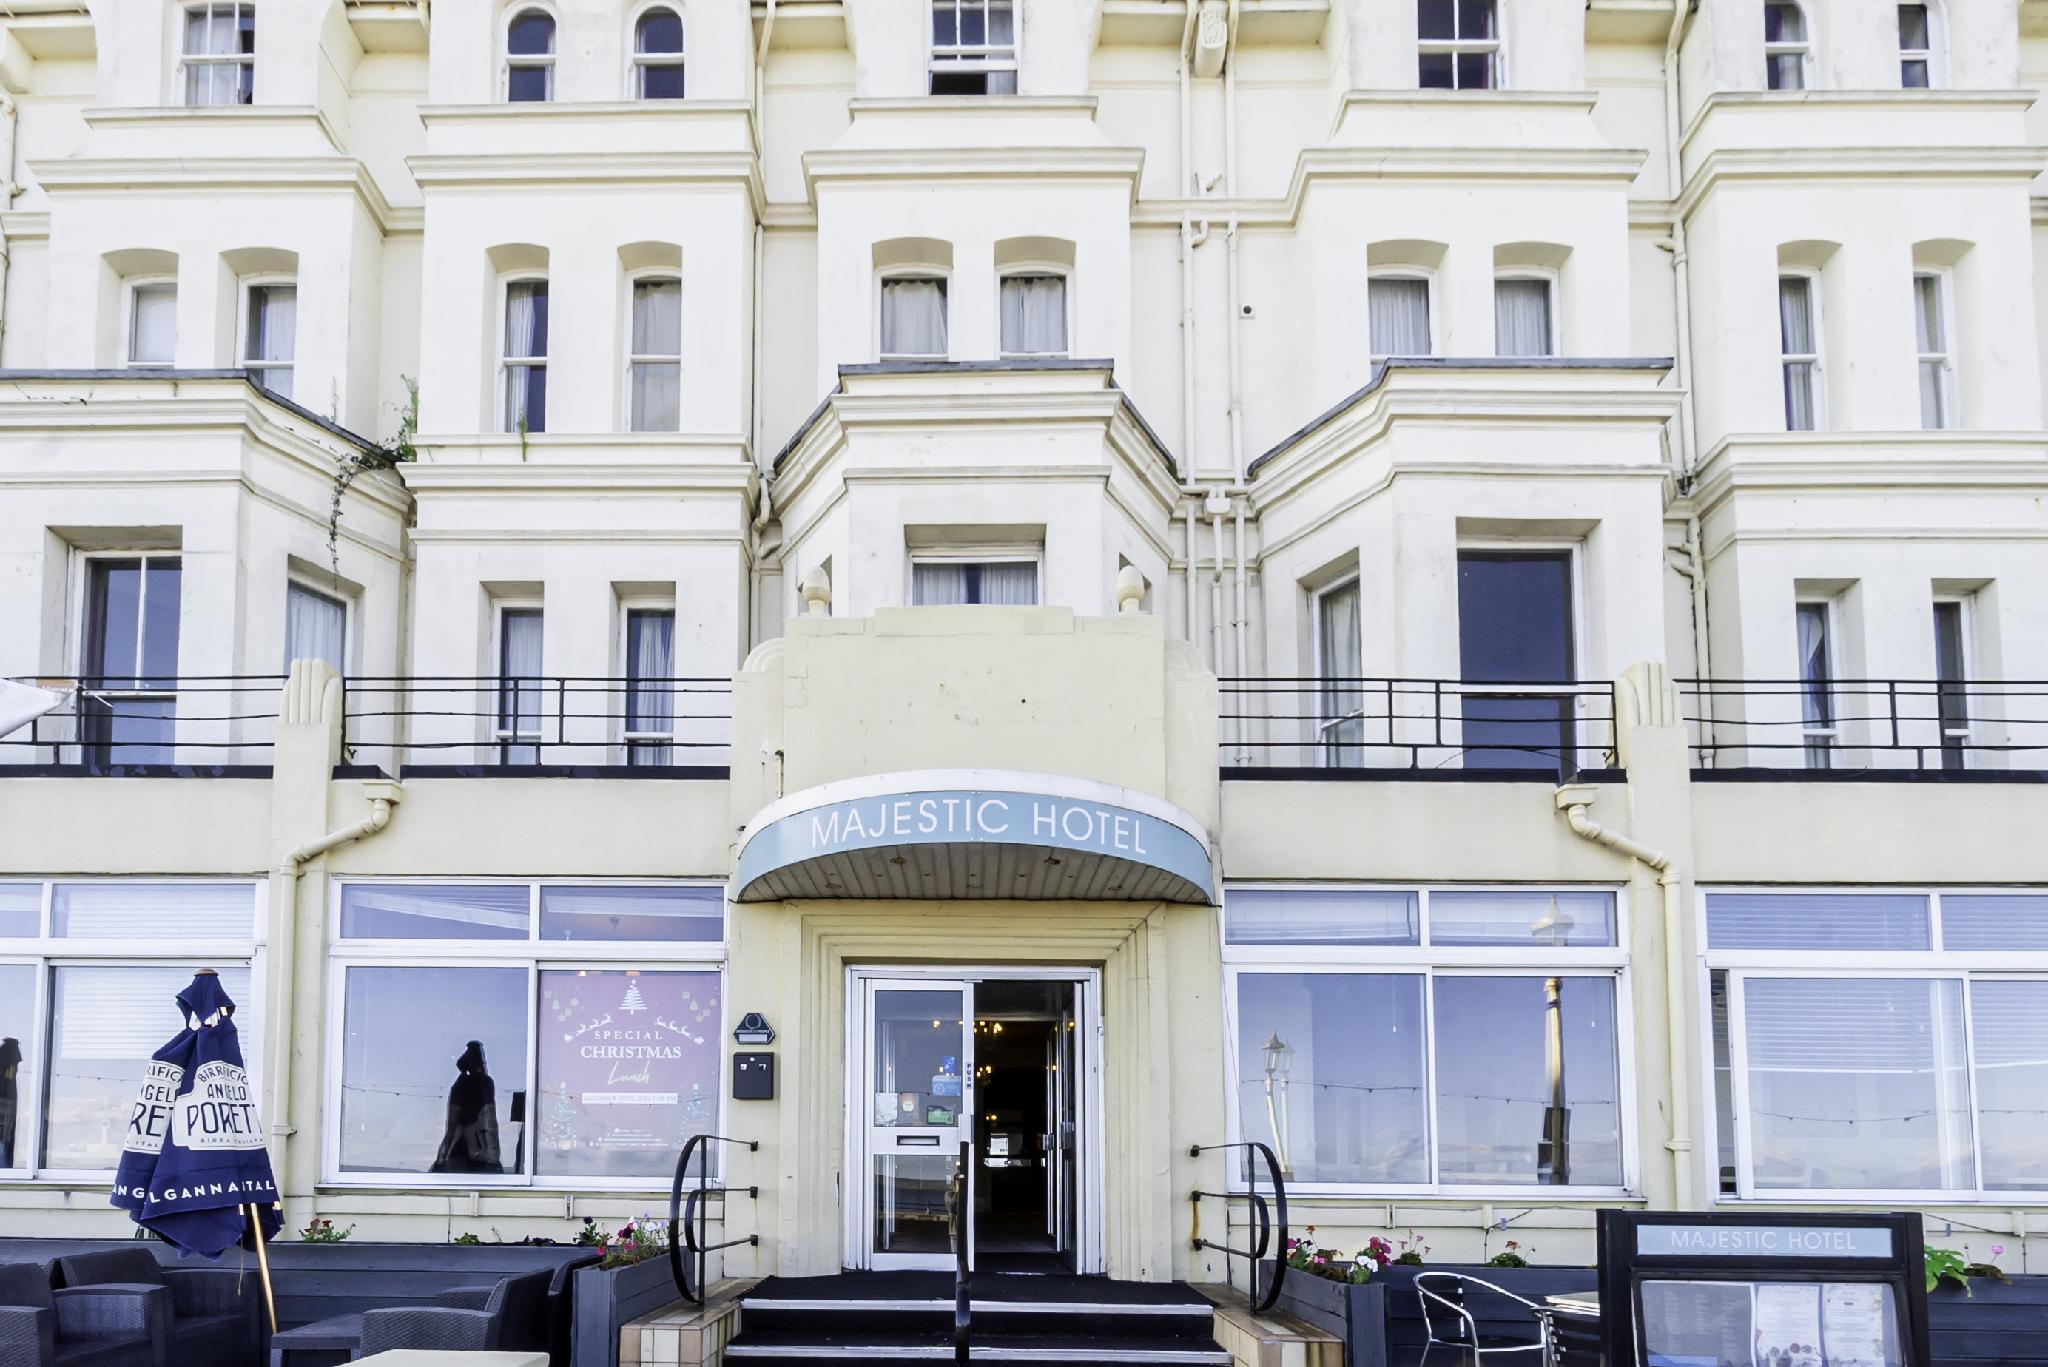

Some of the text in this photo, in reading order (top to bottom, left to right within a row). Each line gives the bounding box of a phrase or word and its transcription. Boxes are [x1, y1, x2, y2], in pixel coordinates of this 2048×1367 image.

[811, 799, 1147, 854] MAJESTIC HOTEL
[594, 1030, 663, 1040] SPECIAL
[580, 1045, 682, 1059] CHRISTMAS
[607, 1060, 651, 1085] Lunch
[140, 1083, 178, 1103] GEL
[207, 1083, 247, 1101] ANELO
[1671, 1231, 1857, 1250] MAJESTIC HOTEL
